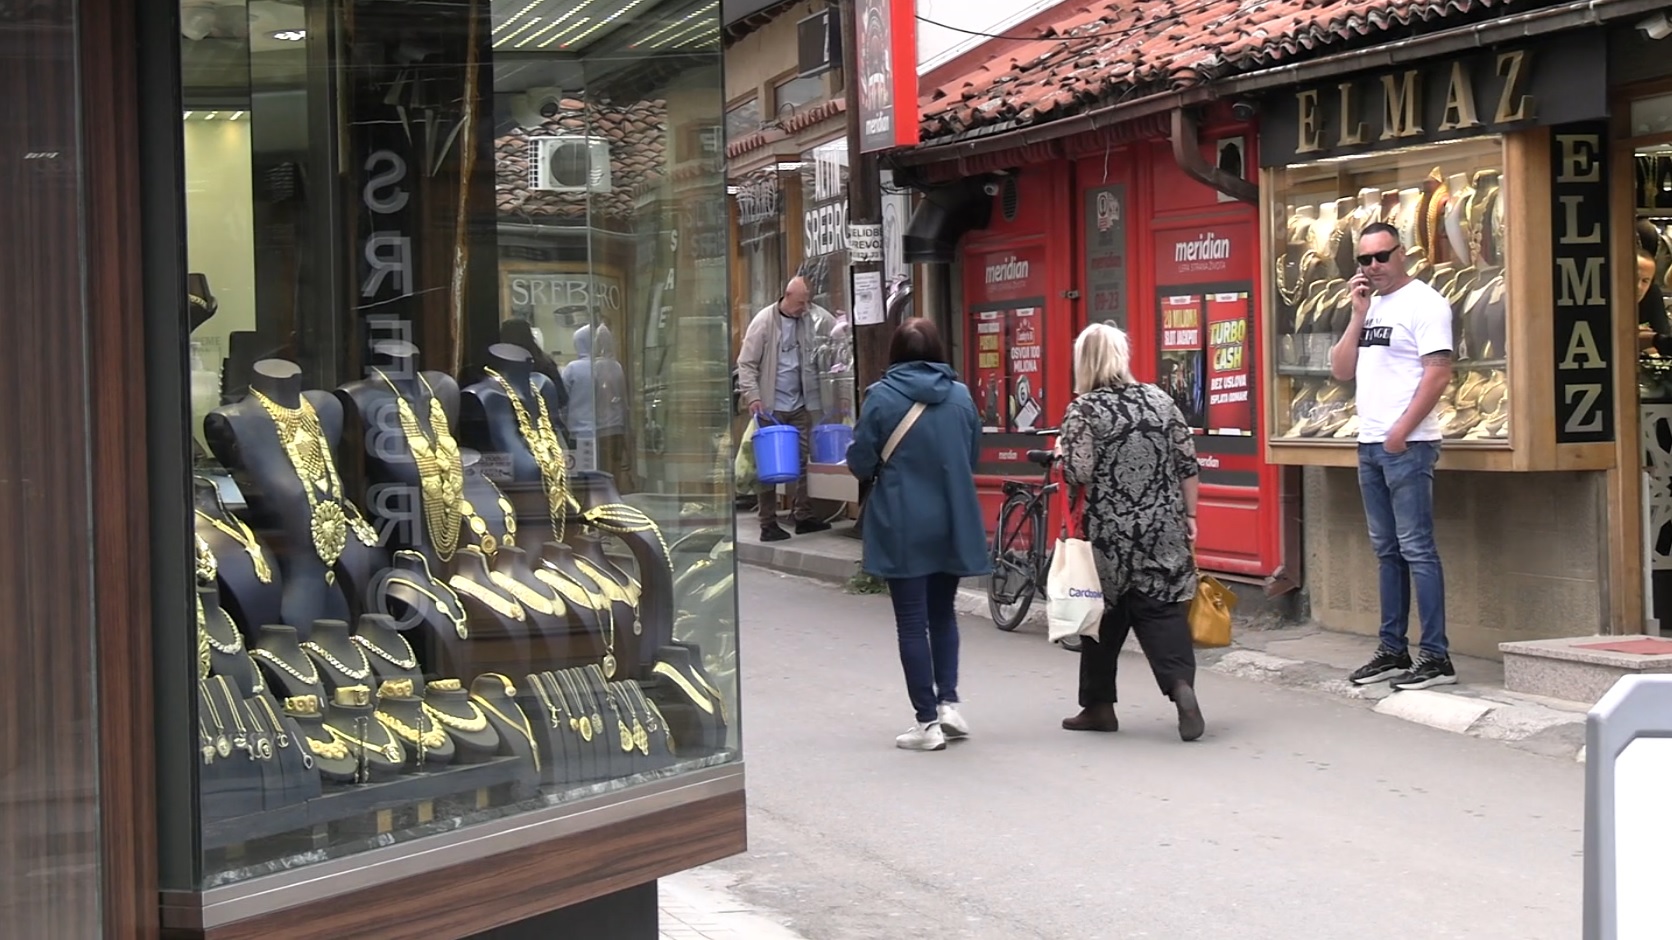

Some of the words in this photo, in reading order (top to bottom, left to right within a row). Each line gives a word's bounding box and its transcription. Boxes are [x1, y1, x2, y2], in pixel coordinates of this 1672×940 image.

[1295, 49, 1538, 155] ELMAZ
[1175, 232, 1230, 262] meridian
[985, 255, 1029, 284] meridian
[1555, 133, 1607, 434] ELMAZ
[1210, 319, 1247, 345] TURBO
[1213, 345, 1243, 371] CASH
